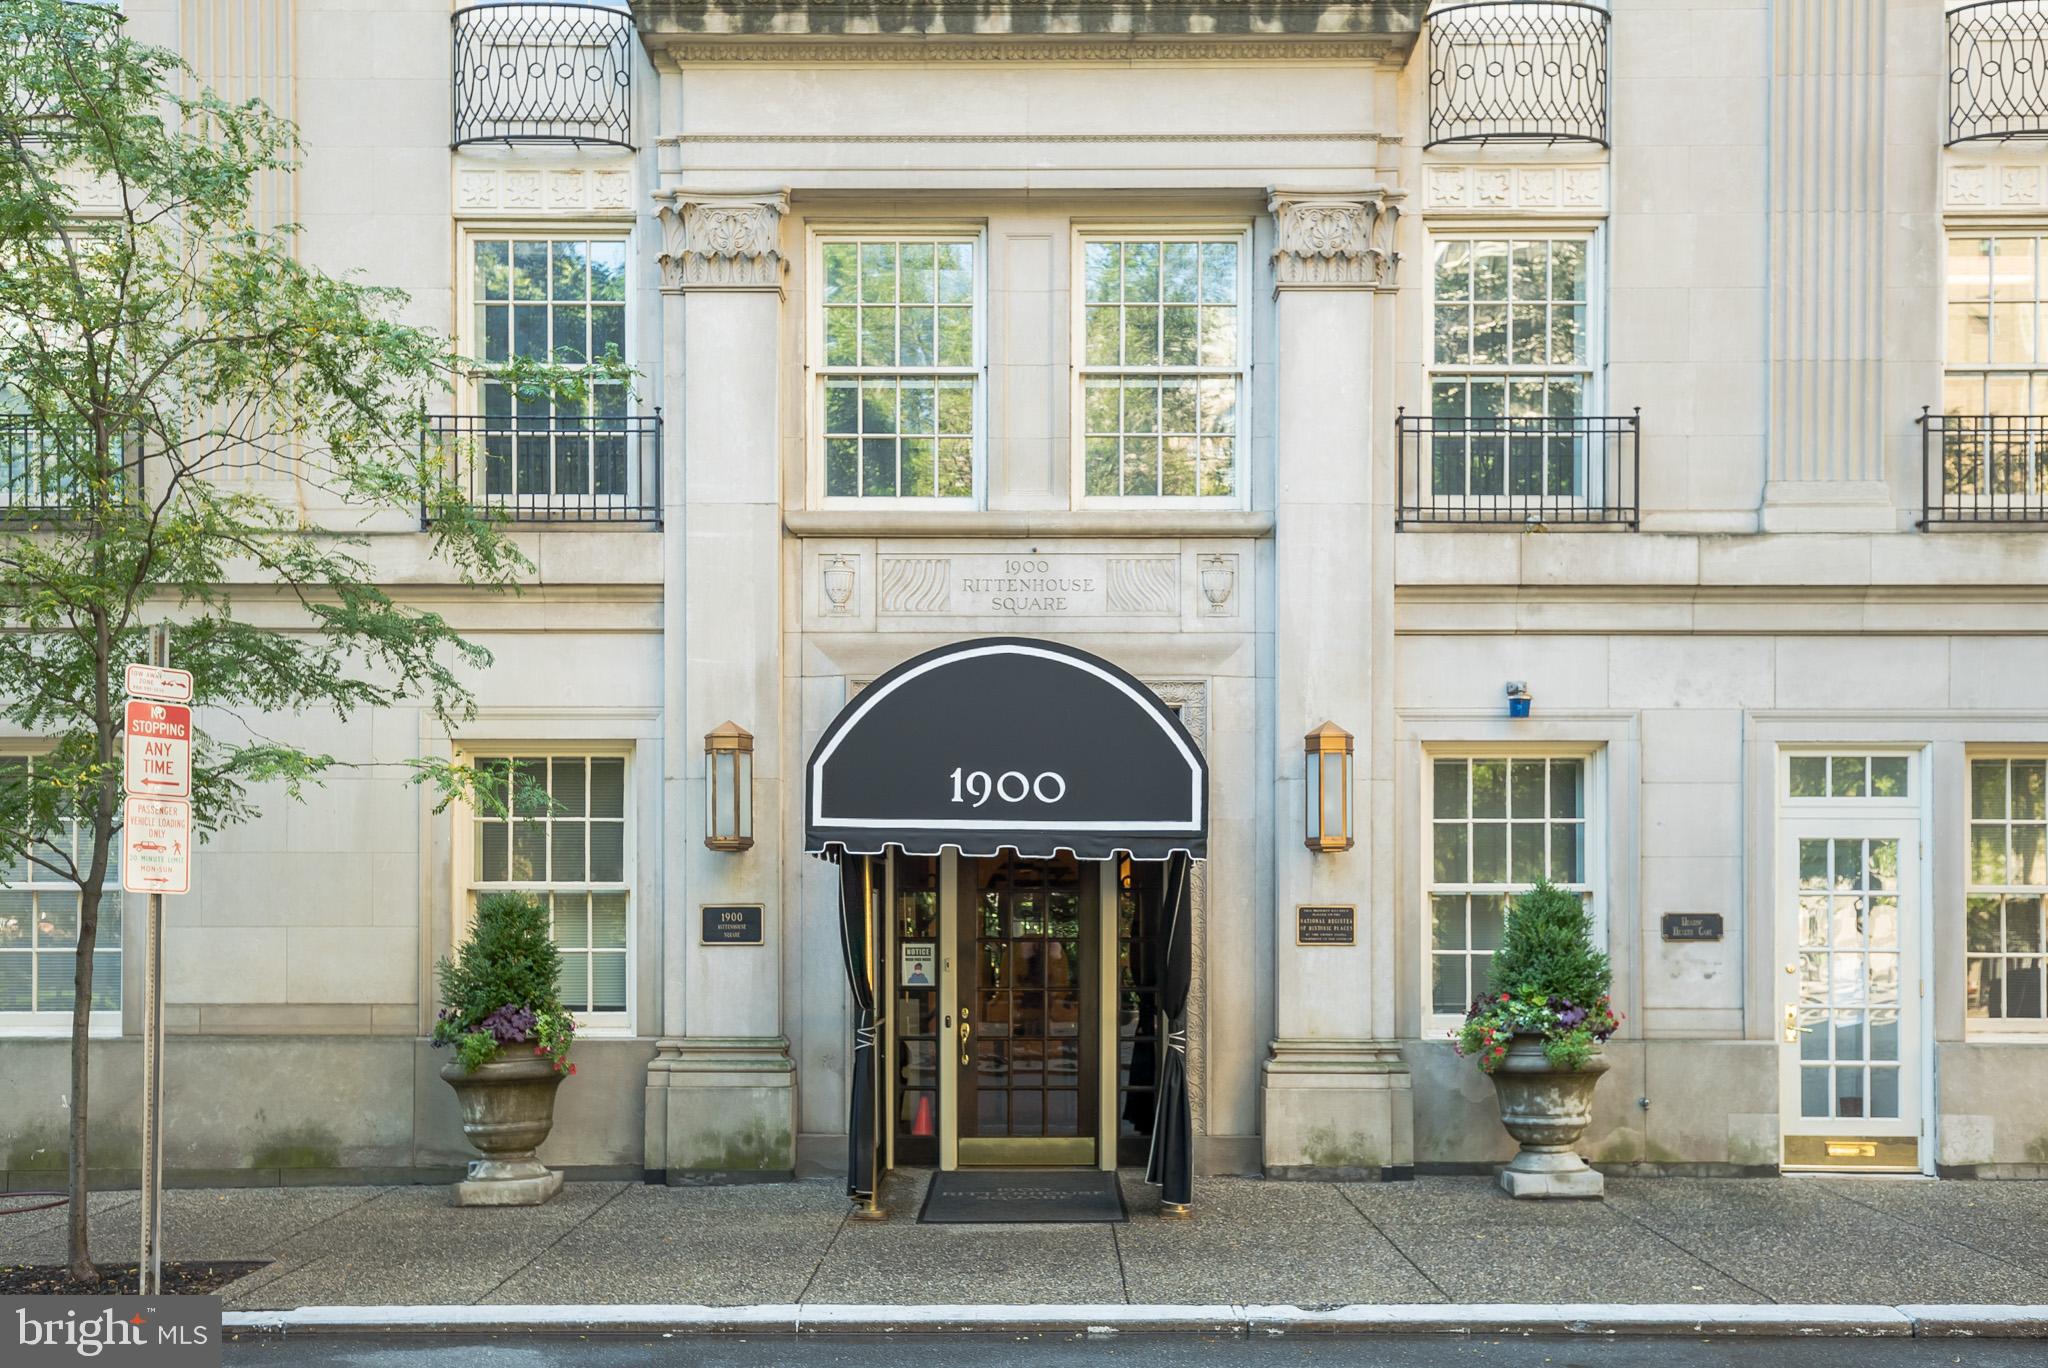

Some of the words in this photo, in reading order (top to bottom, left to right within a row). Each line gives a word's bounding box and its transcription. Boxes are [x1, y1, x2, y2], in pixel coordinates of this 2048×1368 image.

[1005, 559, 1049, 575] 1900
[962, 578, 1096, 593] RITTENHOUSE
[991, 597, 1068, 615] SQUARE
[151, 706, 167, 720] NO
[132, 719, 185, 737] STOPPING
[145, 741, 172, 757] ANY
[143, 758, 174, 775] TIME
[950, 767, 1066, 808] 1900
[137, 804, 178, 816] PASSENGER
[130, 815, 155, 827] VEHICLE
[158, 818, 186, 829] LOADING
[148, 828, 166, 839] ONLY
[141, 855, 164, 863] MINUTE
[721, 912, 743, 922] 1900
